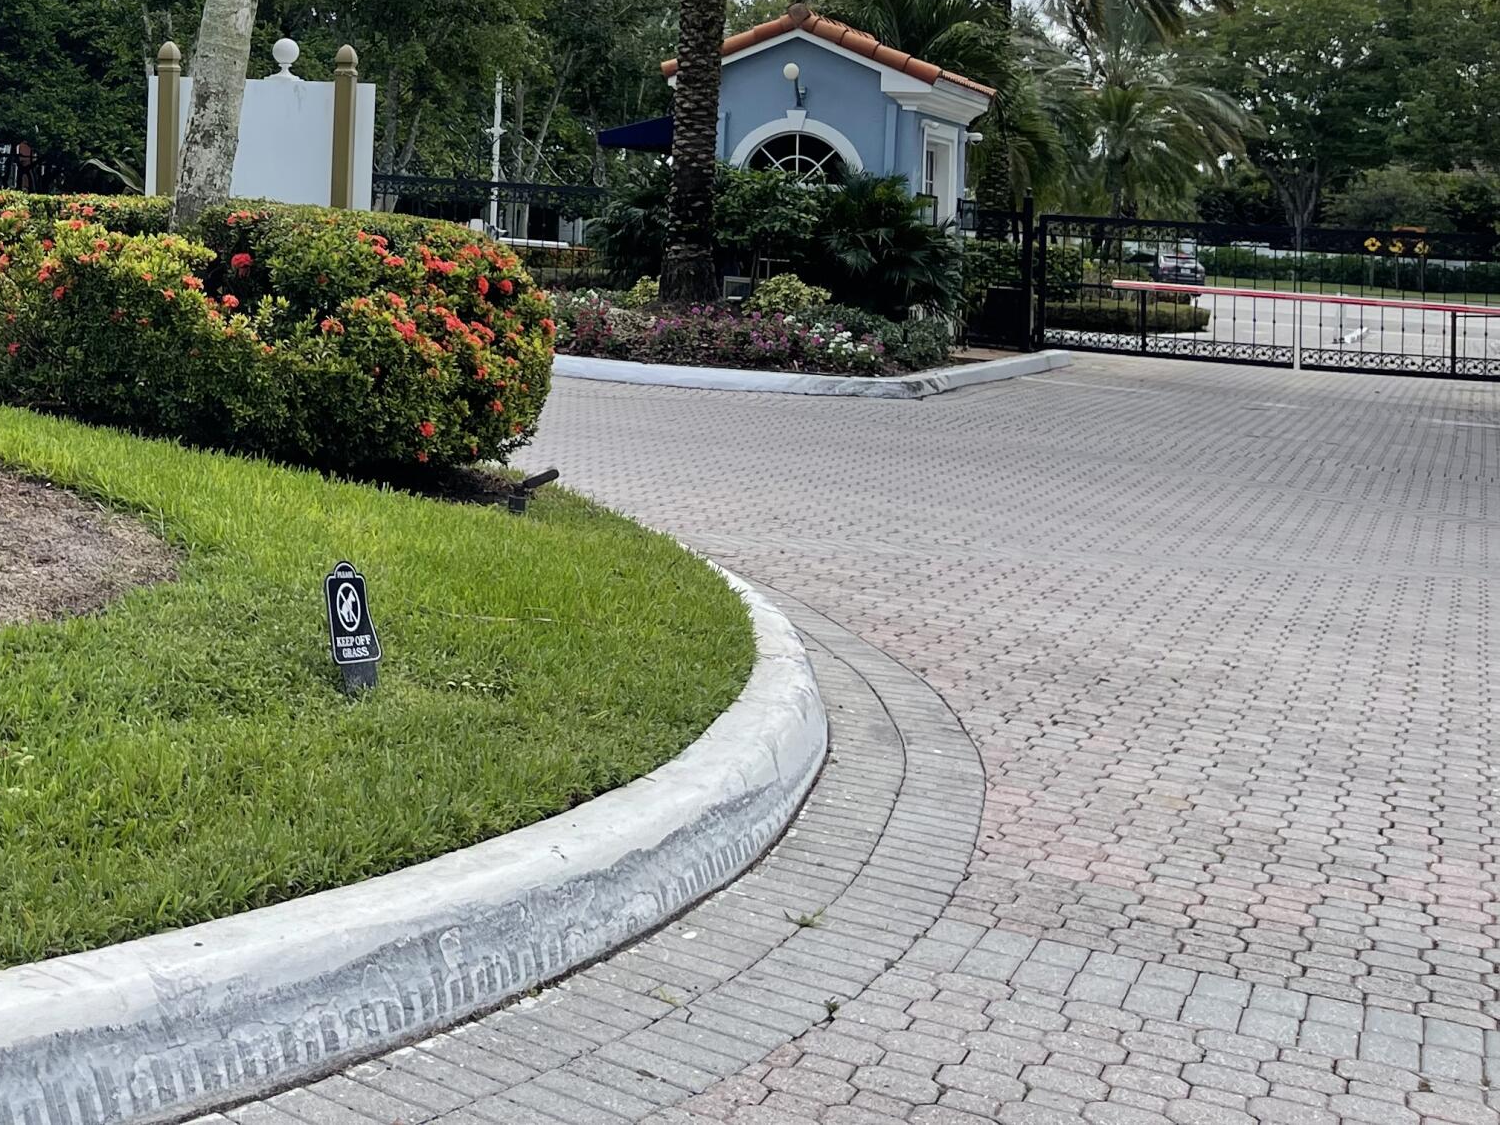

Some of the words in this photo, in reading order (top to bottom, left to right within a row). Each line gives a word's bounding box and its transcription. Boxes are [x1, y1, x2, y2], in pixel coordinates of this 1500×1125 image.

[336, 636, 354, 647] KEEP
[355, 634, 371, 646] OFF
[342, 647, 370, 658] GRASS
